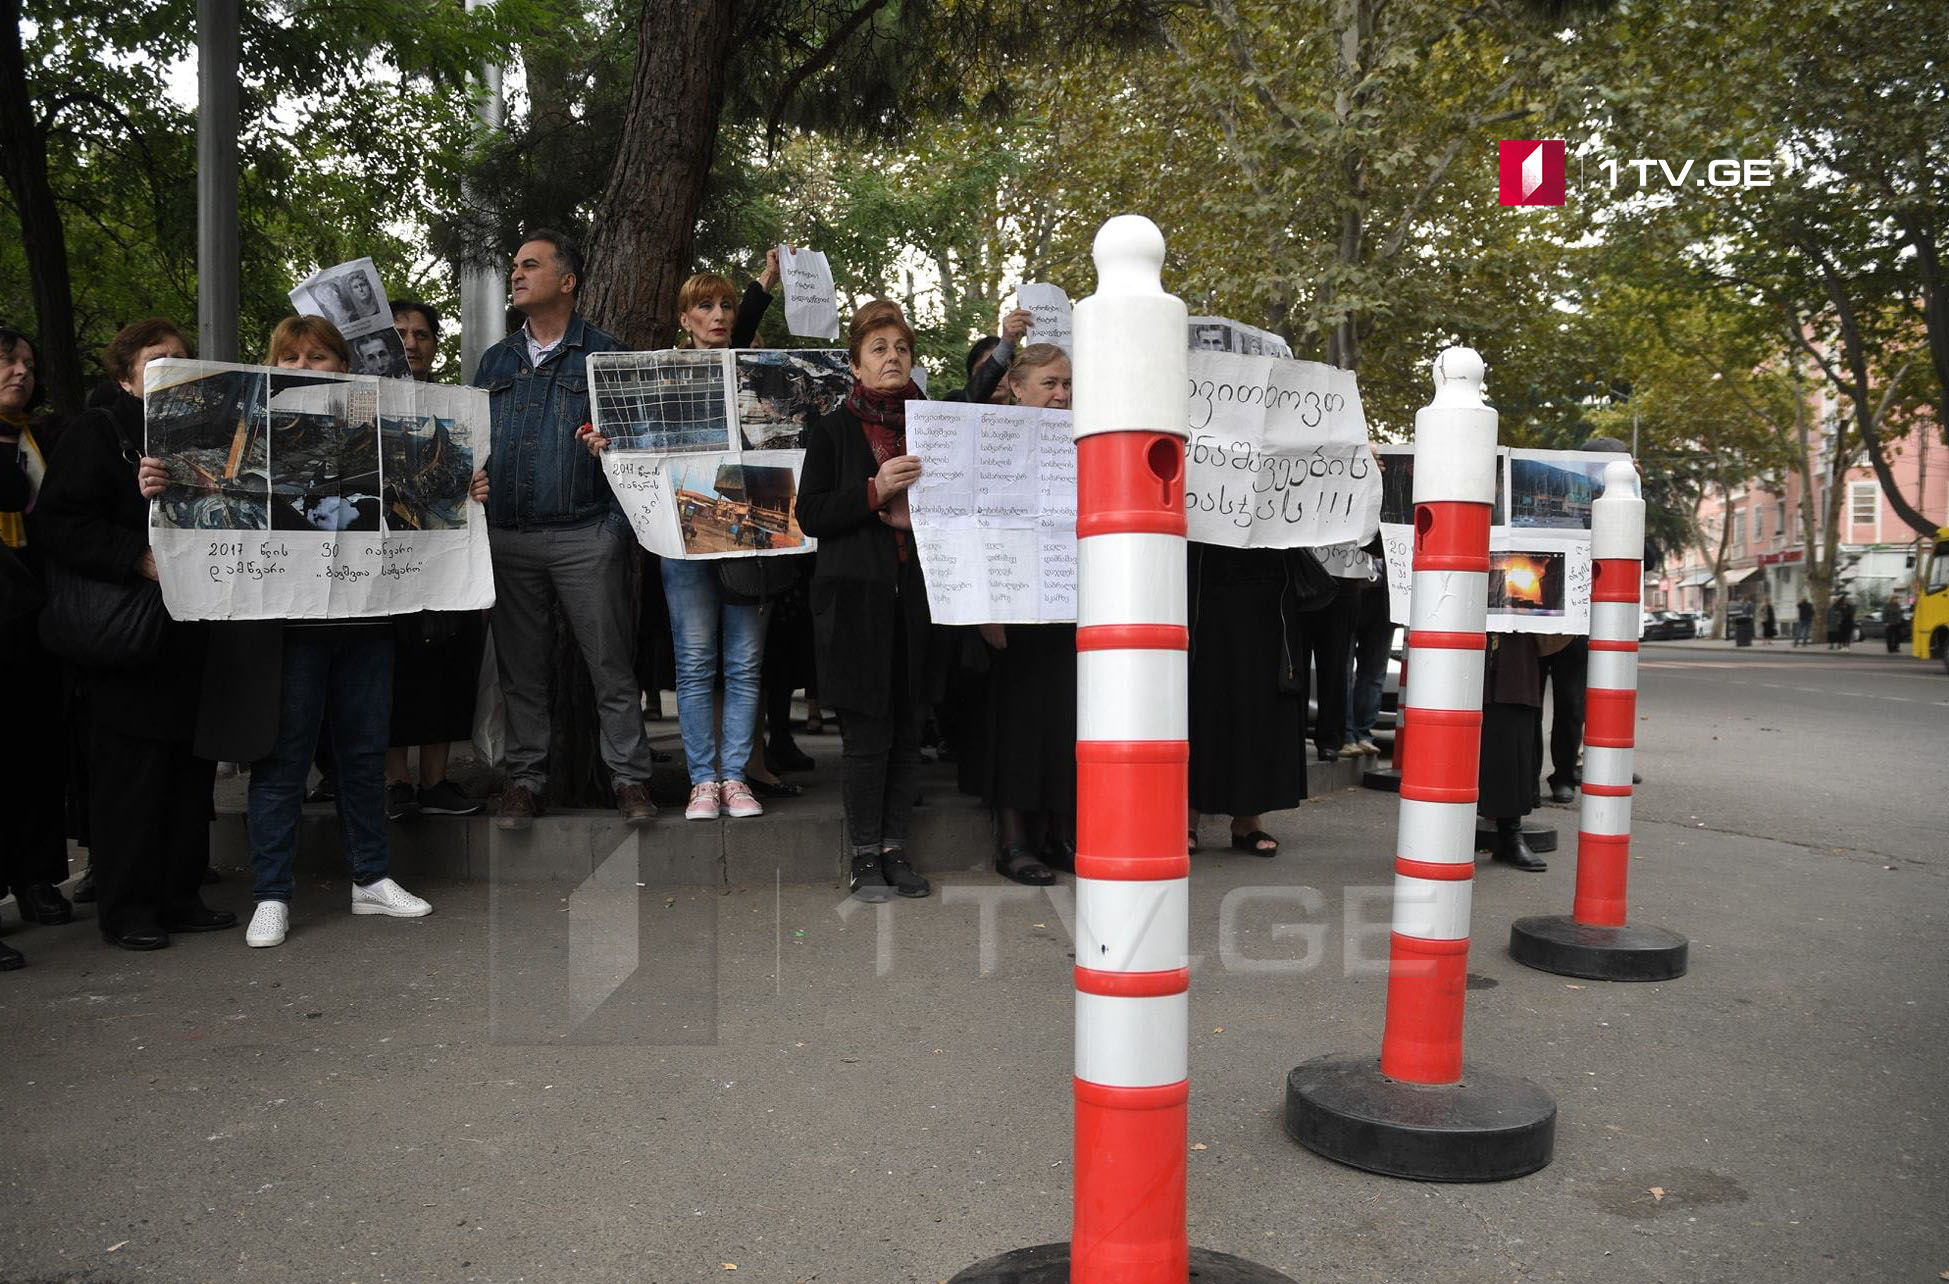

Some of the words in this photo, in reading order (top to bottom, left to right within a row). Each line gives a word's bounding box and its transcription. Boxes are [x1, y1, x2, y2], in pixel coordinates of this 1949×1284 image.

[920, 456, 949, 467] ისხლის
[612, 463, 634, 476] 2017
[208, 543, 243, 557] 2017
[260, 543, 288, 559] წლის
[321, 542, 339, 558] 30
[365, 542, 413, 559] იანვარი
